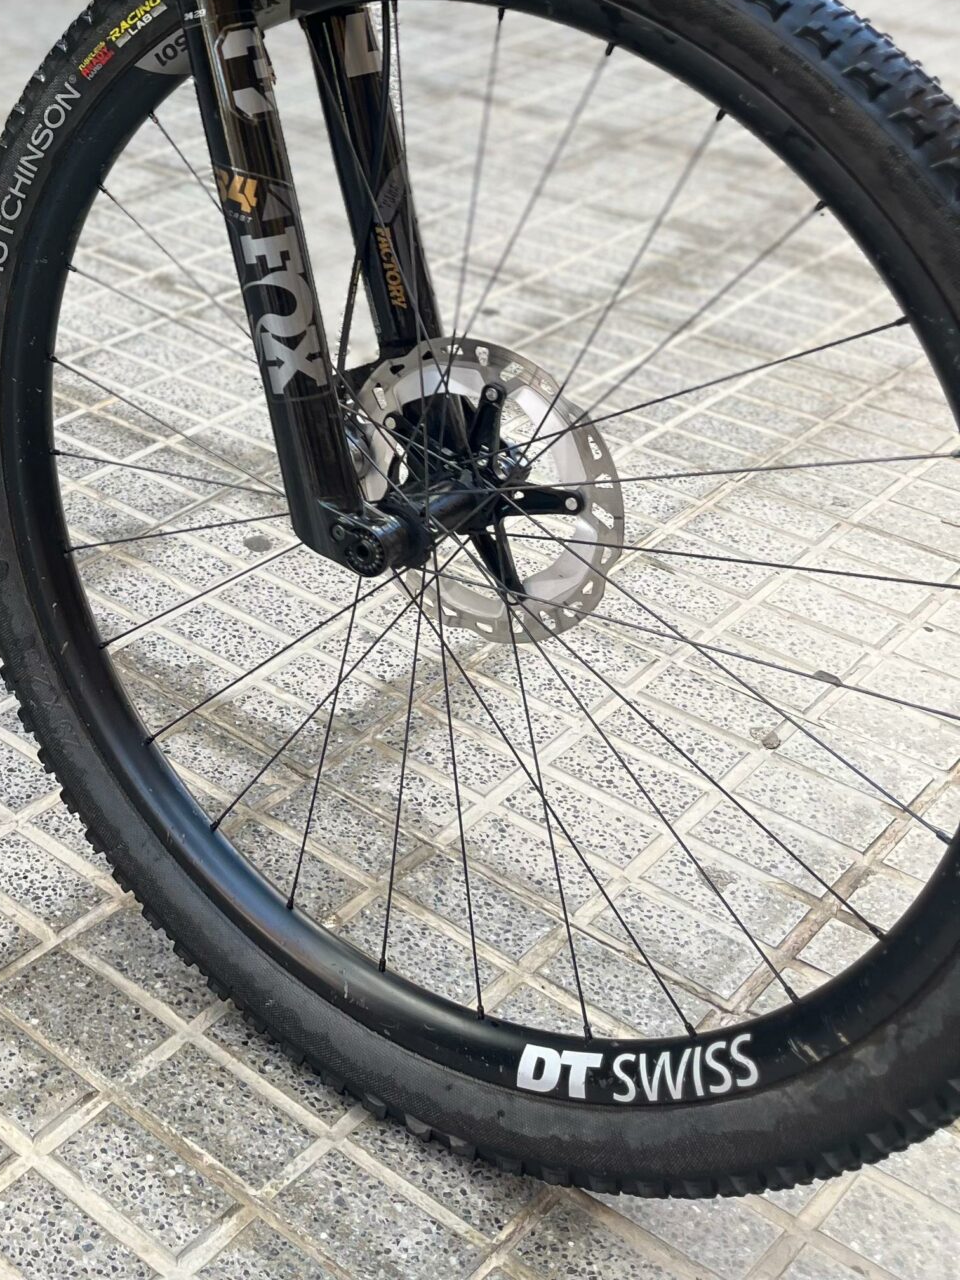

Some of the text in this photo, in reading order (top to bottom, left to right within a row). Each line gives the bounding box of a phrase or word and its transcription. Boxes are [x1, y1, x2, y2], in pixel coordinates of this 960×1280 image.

[127, 12, 153, 36] LAB
[153, 33, 188, 67] 501
[239, 225, 328, 395] FOX
[516, 1033, 759, 1103] DT SWISS
